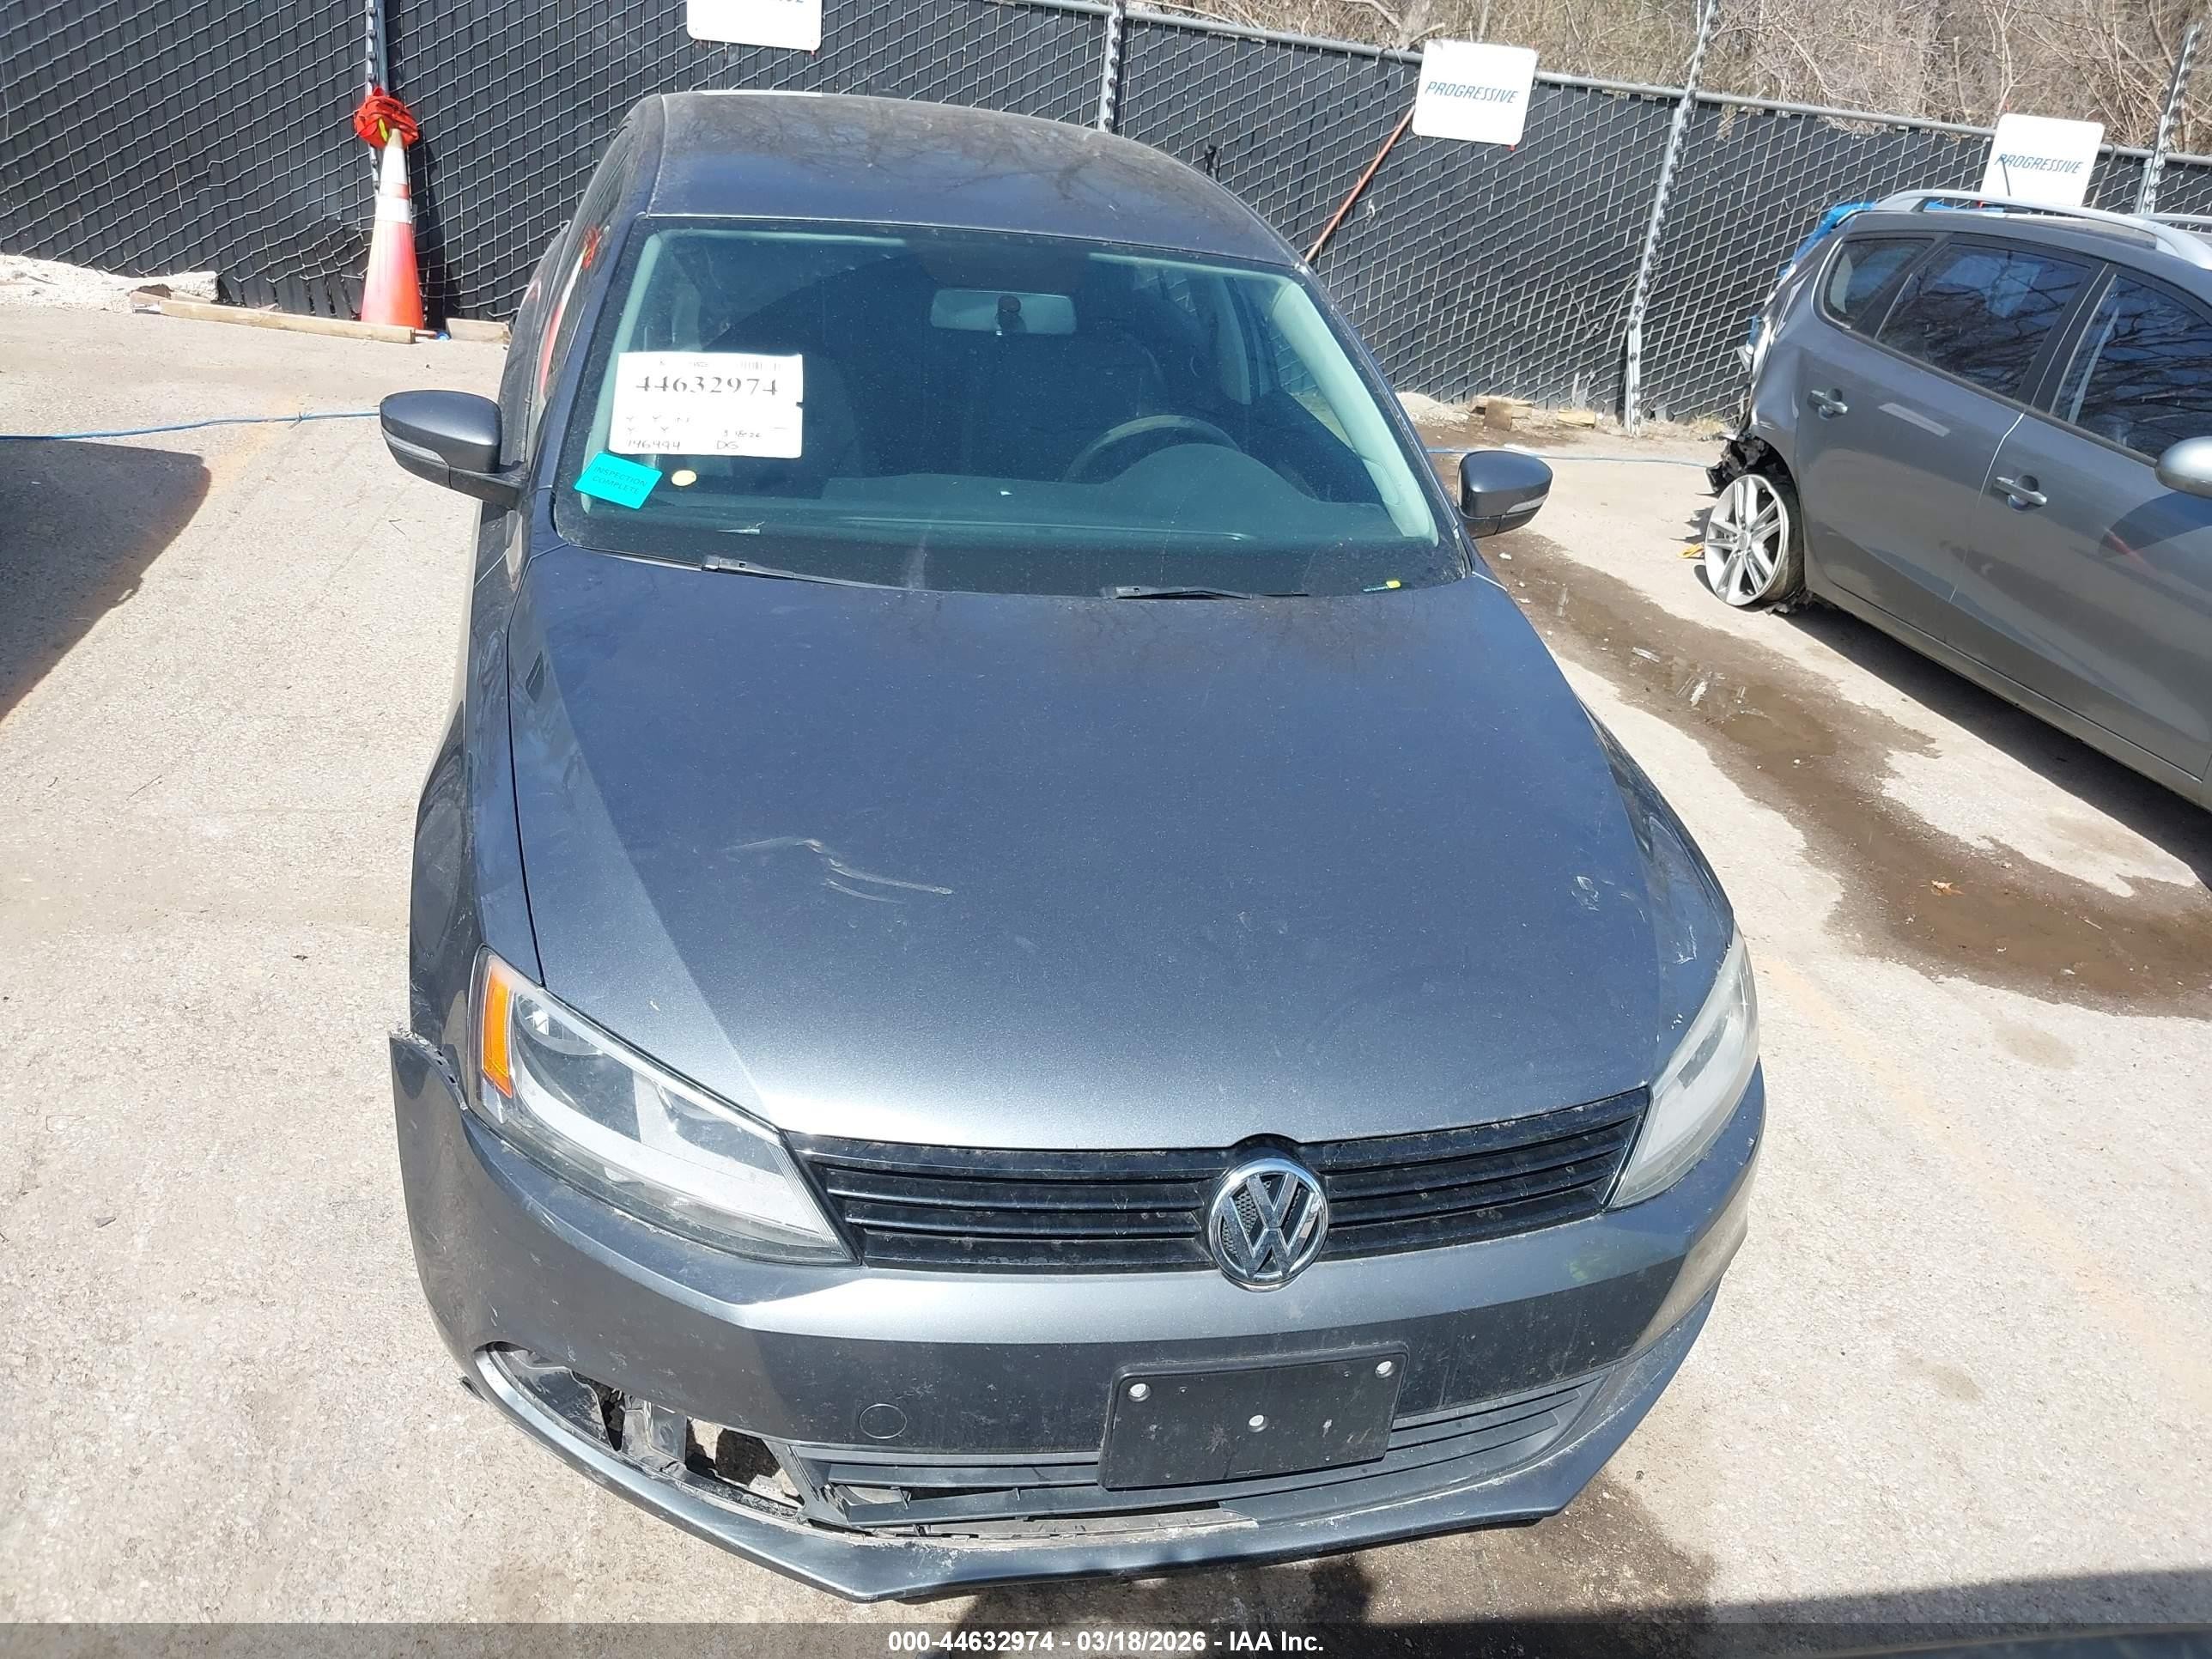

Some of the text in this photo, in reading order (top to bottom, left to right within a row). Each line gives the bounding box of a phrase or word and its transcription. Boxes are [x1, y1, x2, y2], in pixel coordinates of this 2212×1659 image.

[1425, 81, 1519, 104] PROGRESSIVE
[1994, 153, 2084, 173] PROGRESSIVE
[635, 375, 778, 396] 44632974
[592, 476, 640, 495] COMPLETE
[593, 466, 647, 487] INSPECTION
